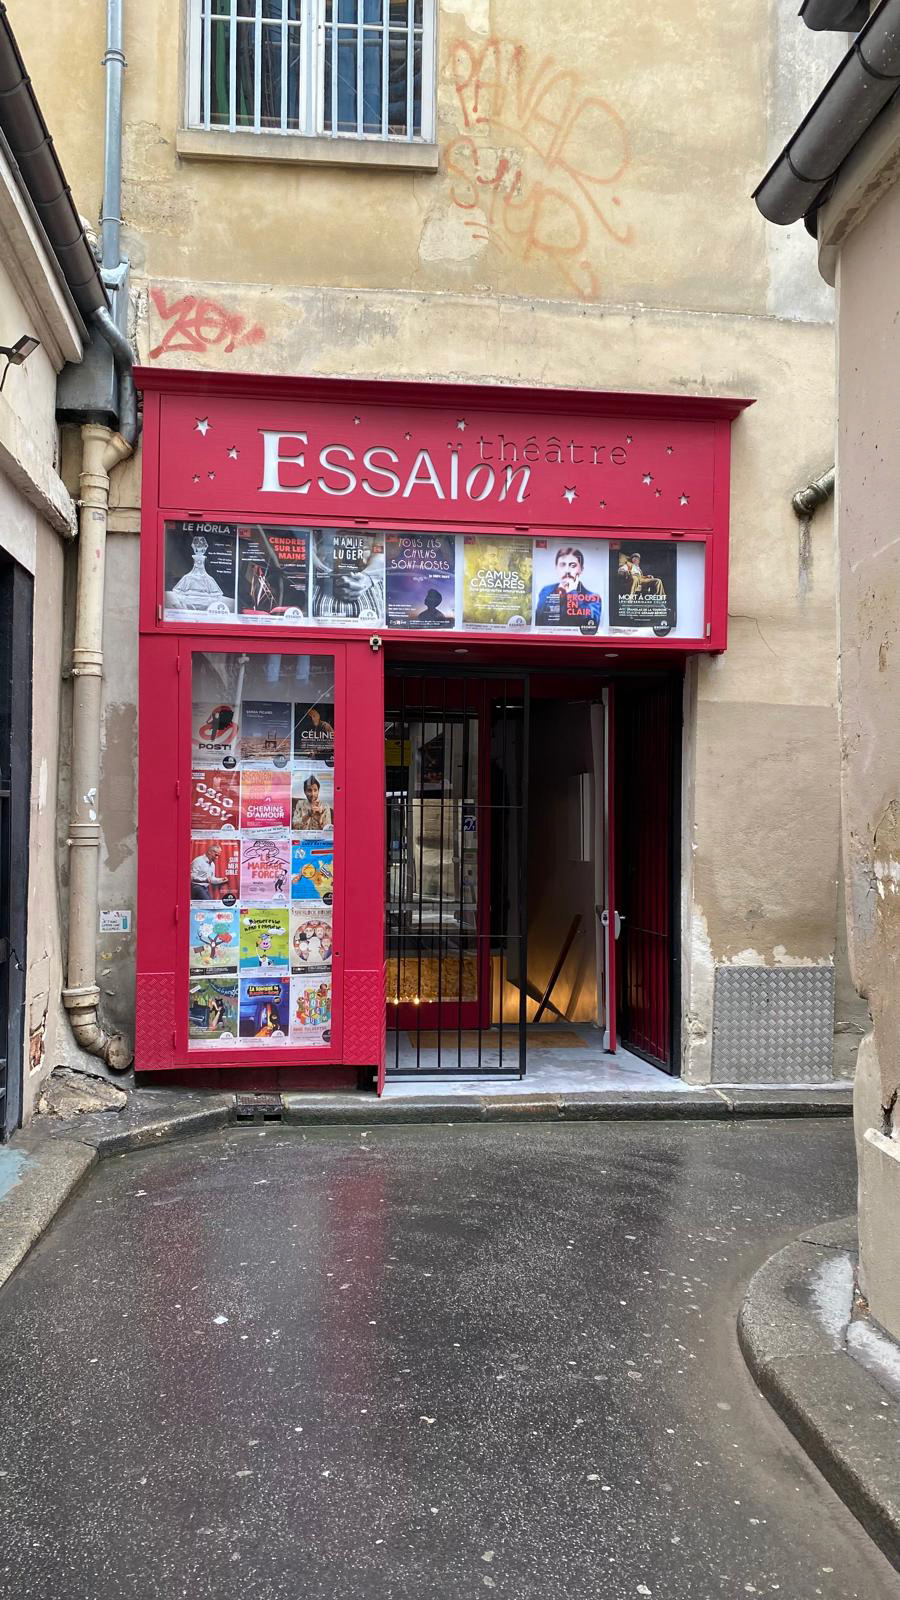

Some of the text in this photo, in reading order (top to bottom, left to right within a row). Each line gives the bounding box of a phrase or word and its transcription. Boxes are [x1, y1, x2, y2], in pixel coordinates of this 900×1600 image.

[476, 434, 628, 466] théâtre
[182, 522, 231, 534] LE HORLA
[269, 536, 306, 546] CENDRES
[333, 537, 364, 547] MAMIE
[398, 537, 423, 548] TOUS
[278, 553, 306, 561] MAINS
[333, 549, 364, 561] LUGER
[403, 548, 437, 559] CHIENS
[391, 560, 450, 571] SONT ROSES
[477, 569, 519, 580] CAMUS
[470, 579, 525, 590] CASARES
[566, 594, 600, 602] PROUST
[644, 593, 667, 601] CRÉDIT
[566, 608, 592, 616] CLAIR
[301, 729, 334, 739] CÉLINE
[247, 805, 284, 813] CHEMINS
[246, 811, 285, 819] D'AMOUR
[260, 853, 270, 861] LE
[247, 862, 283, 870] MARIAGE
